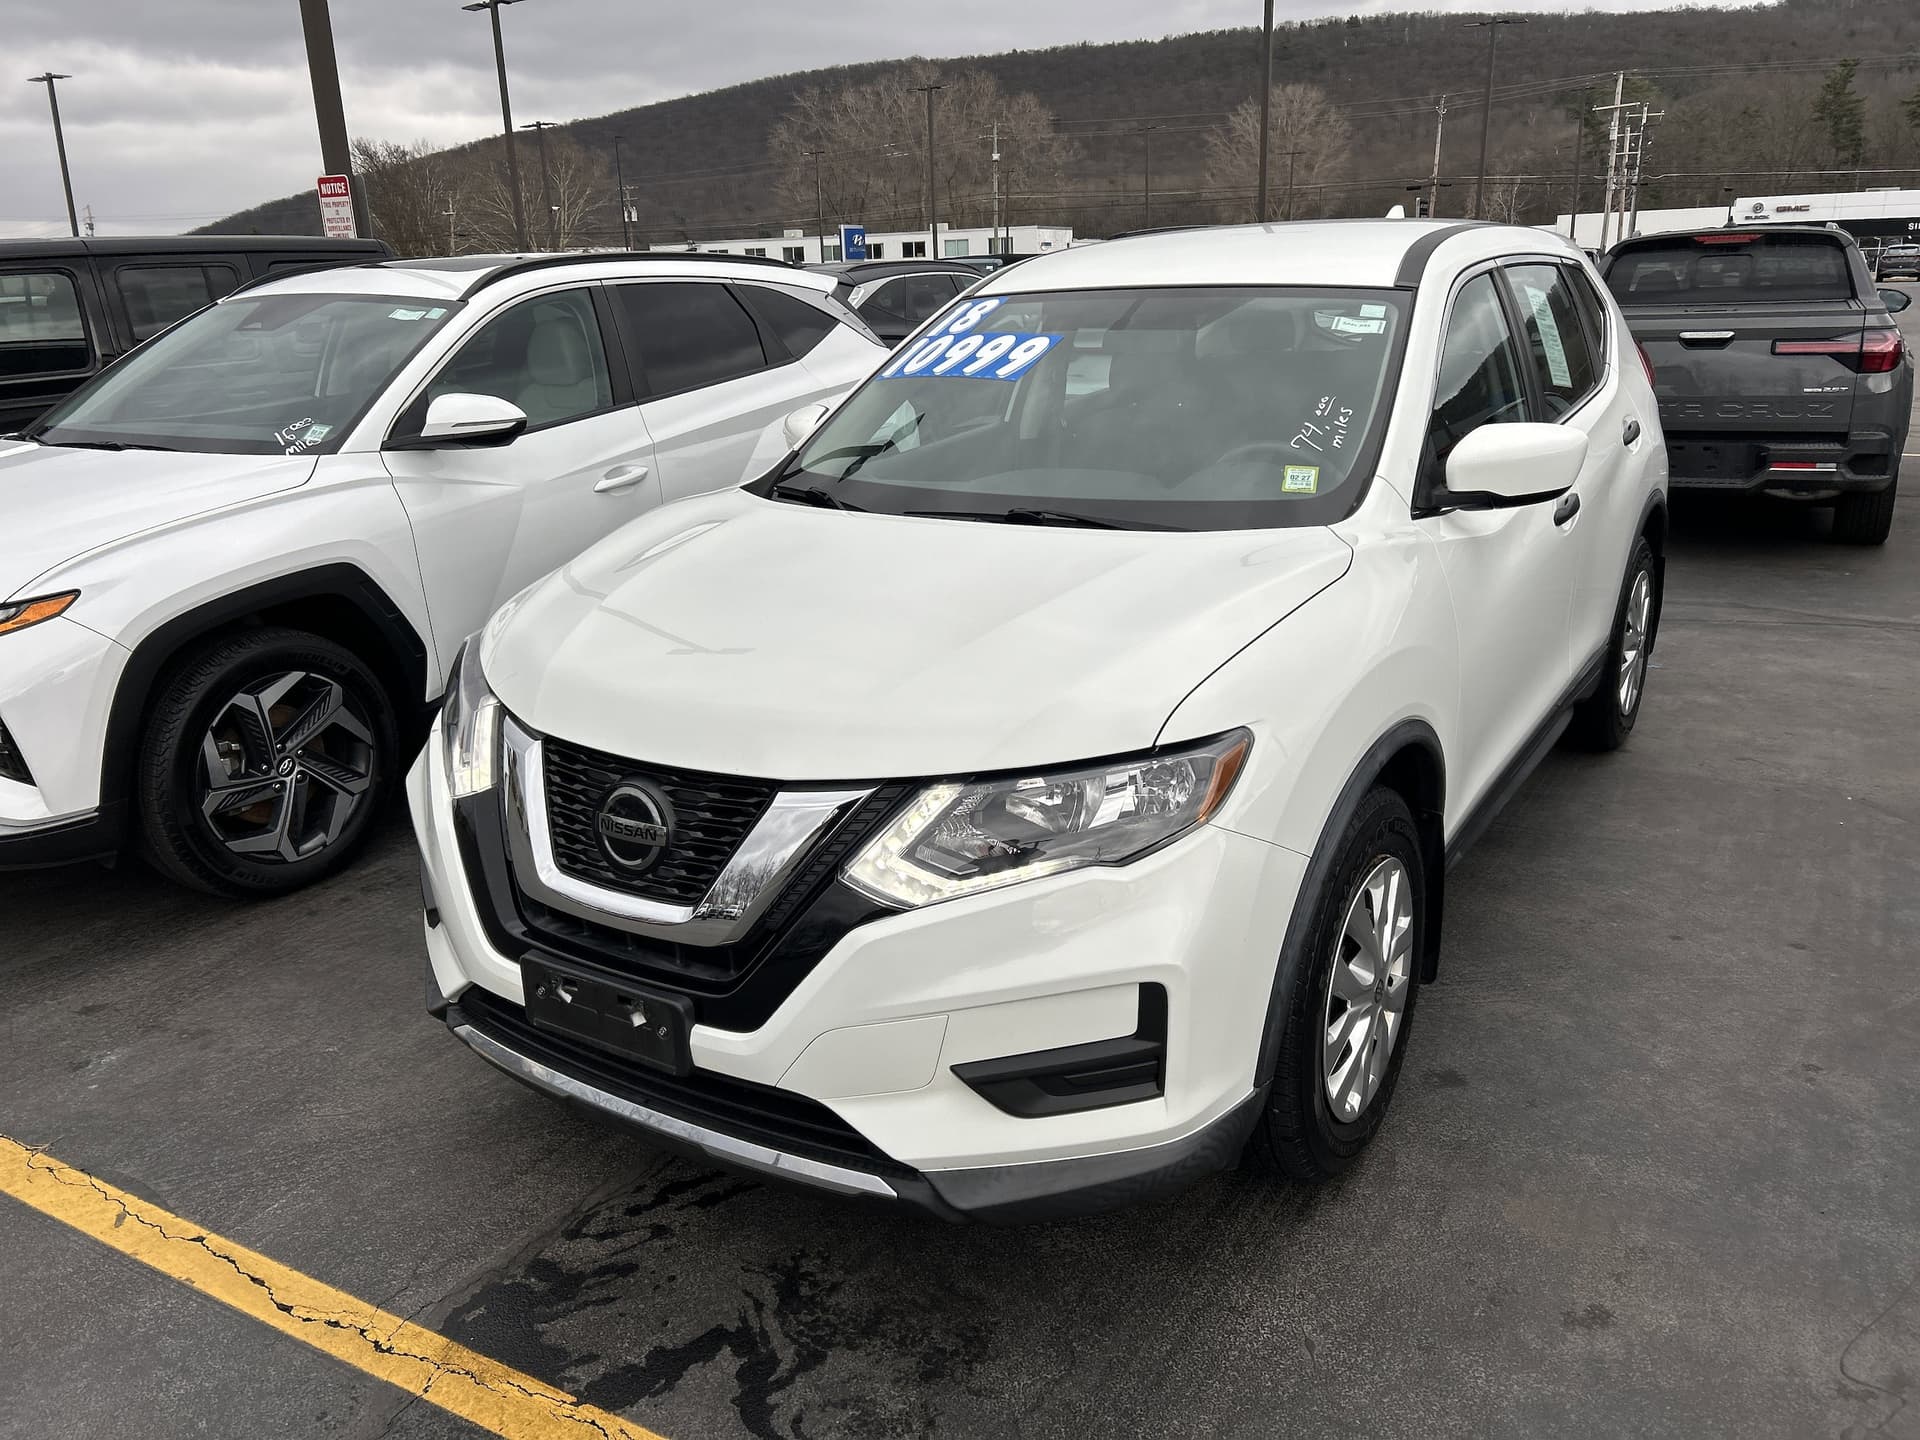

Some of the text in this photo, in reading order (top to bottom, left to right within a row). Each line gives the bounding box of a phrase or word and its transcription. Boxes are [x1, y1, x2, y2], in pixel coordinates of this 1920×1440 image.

[320, 183, 346, 195] NOTICE
[1776, 204, 1810, 213] GMC
[927, 298, 1000, 337] 18
[882, 334, 1051, 379] 10999
[1716, 403, 1835, 418] CRUZ
[601, 819, 657, 841] NISSAN
